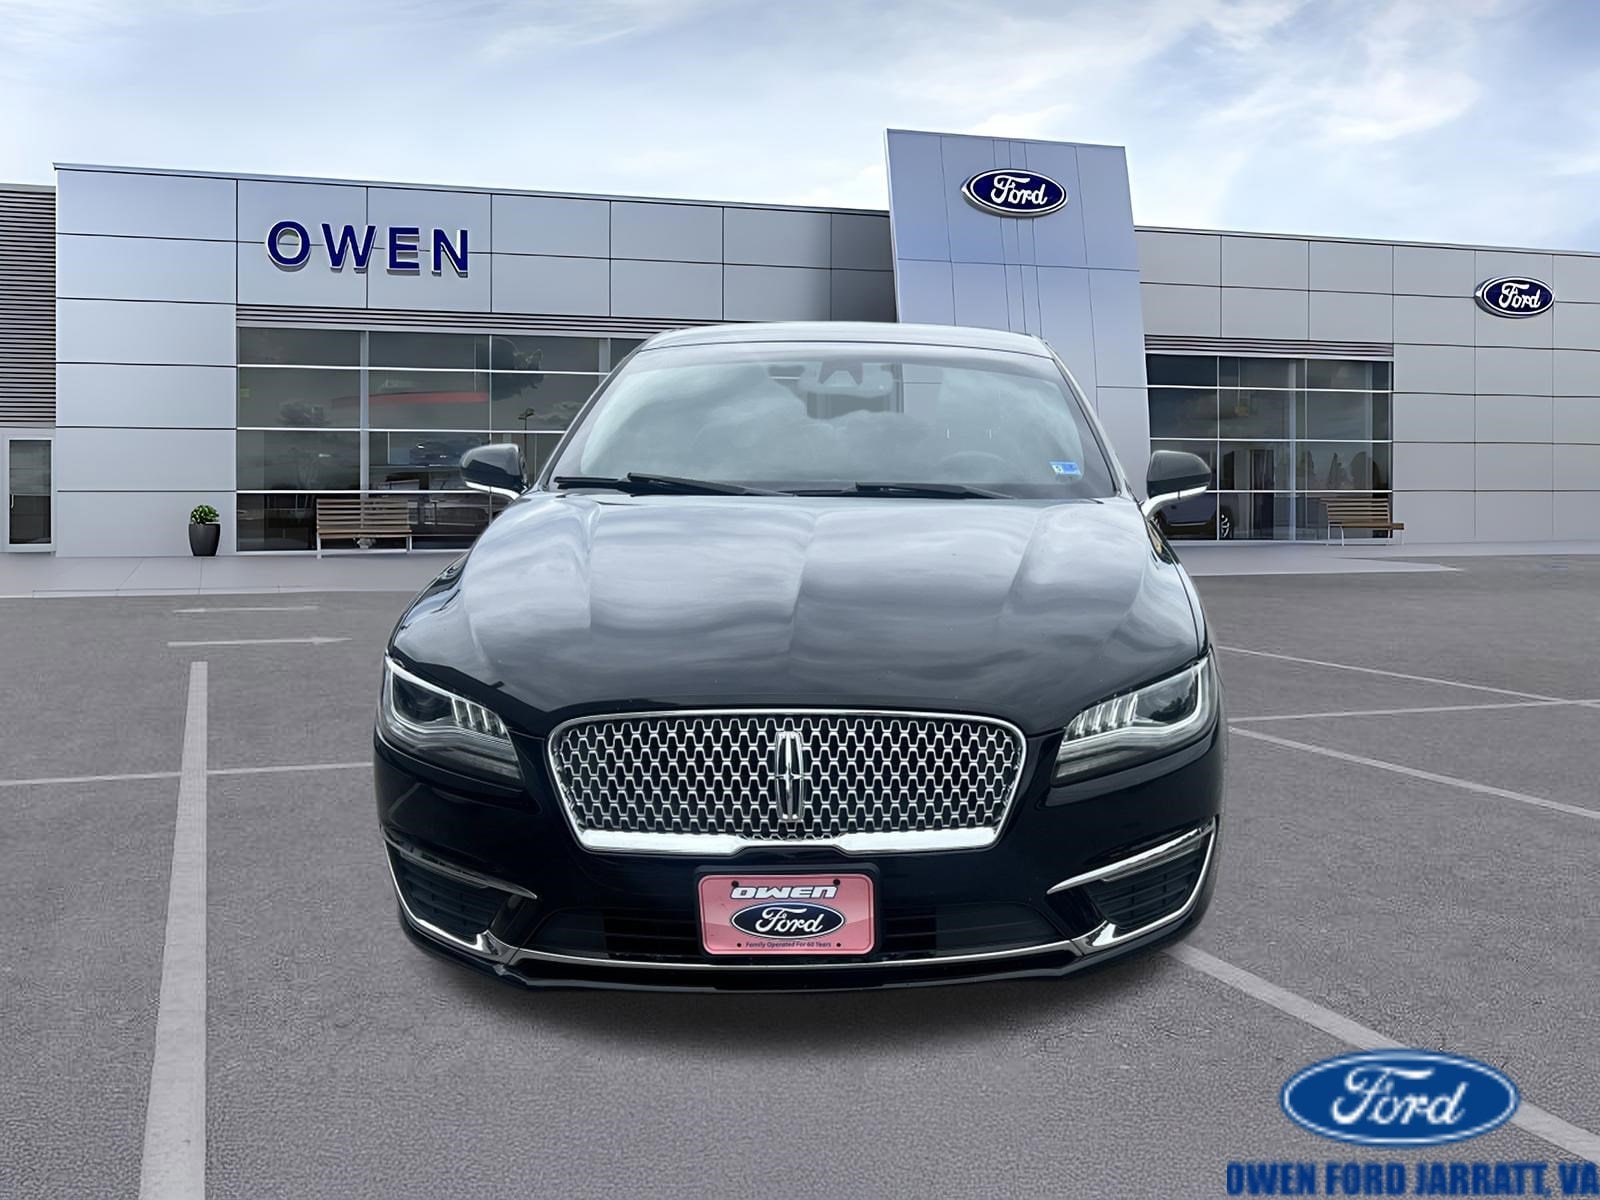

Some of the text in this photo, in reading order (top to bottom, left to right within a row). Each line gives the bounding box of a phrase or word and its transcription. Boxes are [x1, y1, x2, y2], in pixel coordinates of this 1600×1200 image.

[990, 175, 1048, 205] Ford
[266, 220, 469, 278] OWEN
[1498, 282, 1541, 308] Ford
[731, 886, 839, 899] OWEN
[755, 907, 825, 932] Ford
